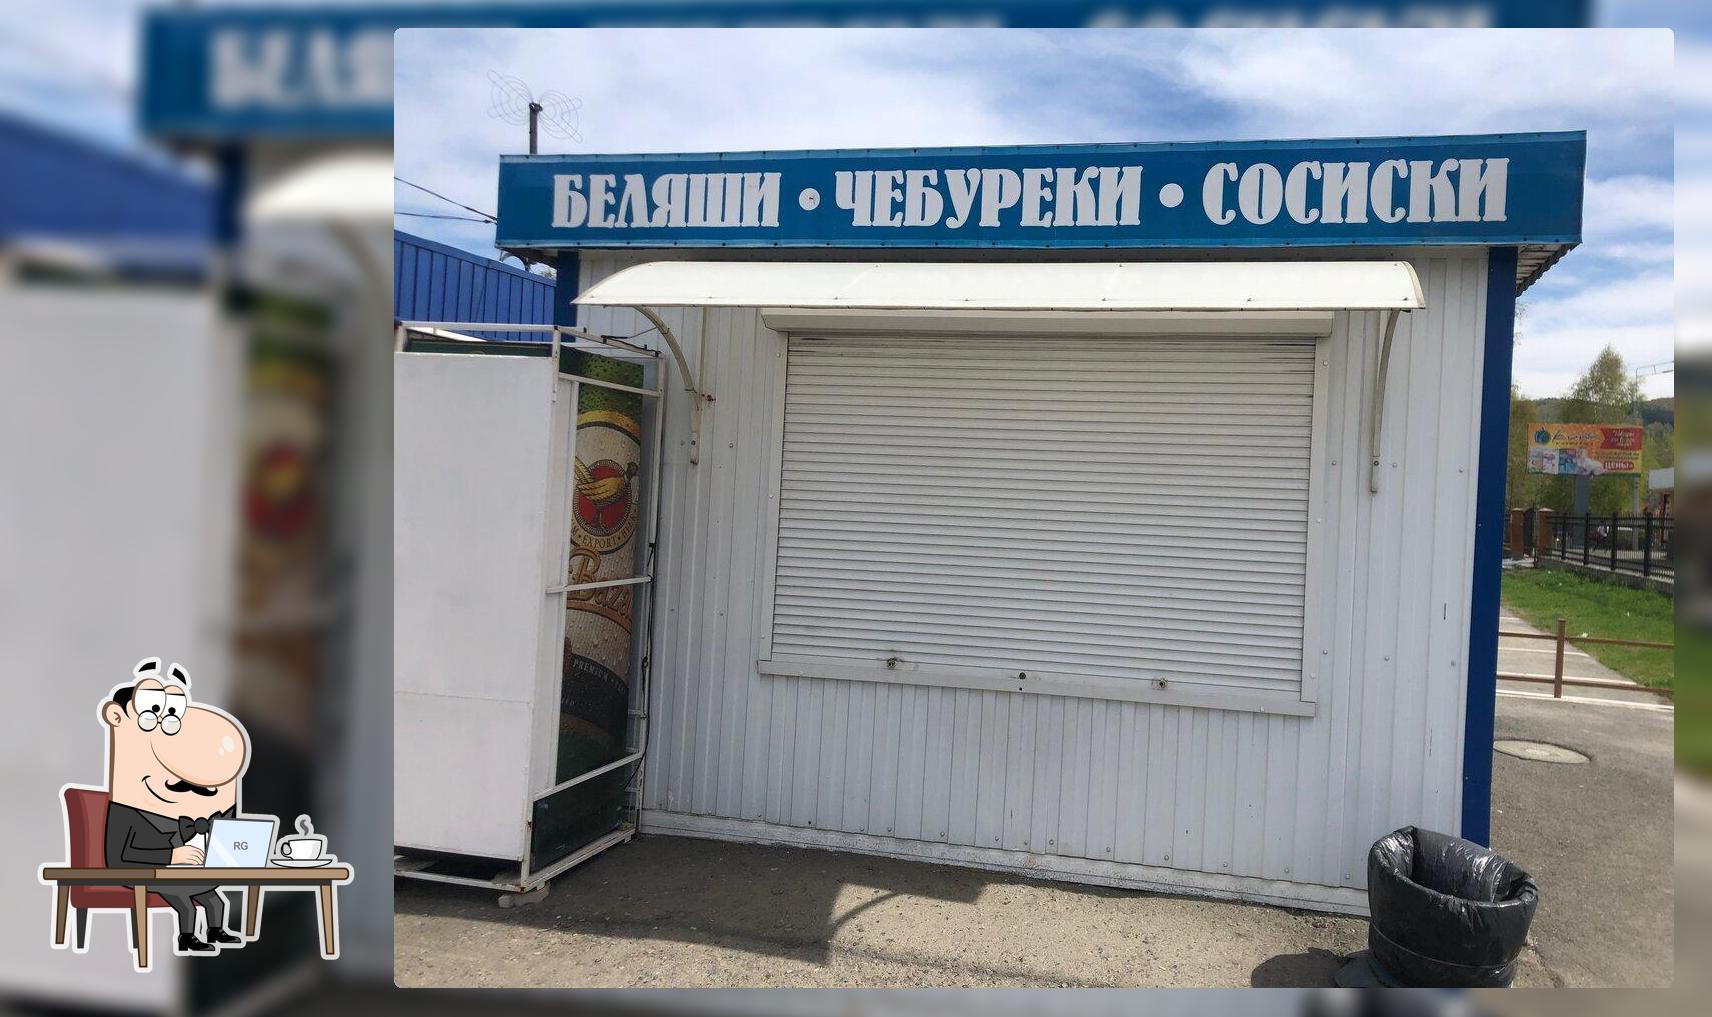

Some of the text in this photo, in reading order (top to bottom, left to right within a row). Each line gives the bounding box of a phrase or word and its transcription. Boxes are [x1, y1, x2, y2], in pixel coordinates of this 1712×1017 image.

[553, 157, 1509, 230] БЕЛЯШИ ЧЕБУРЕКИ СОСИСКИ
